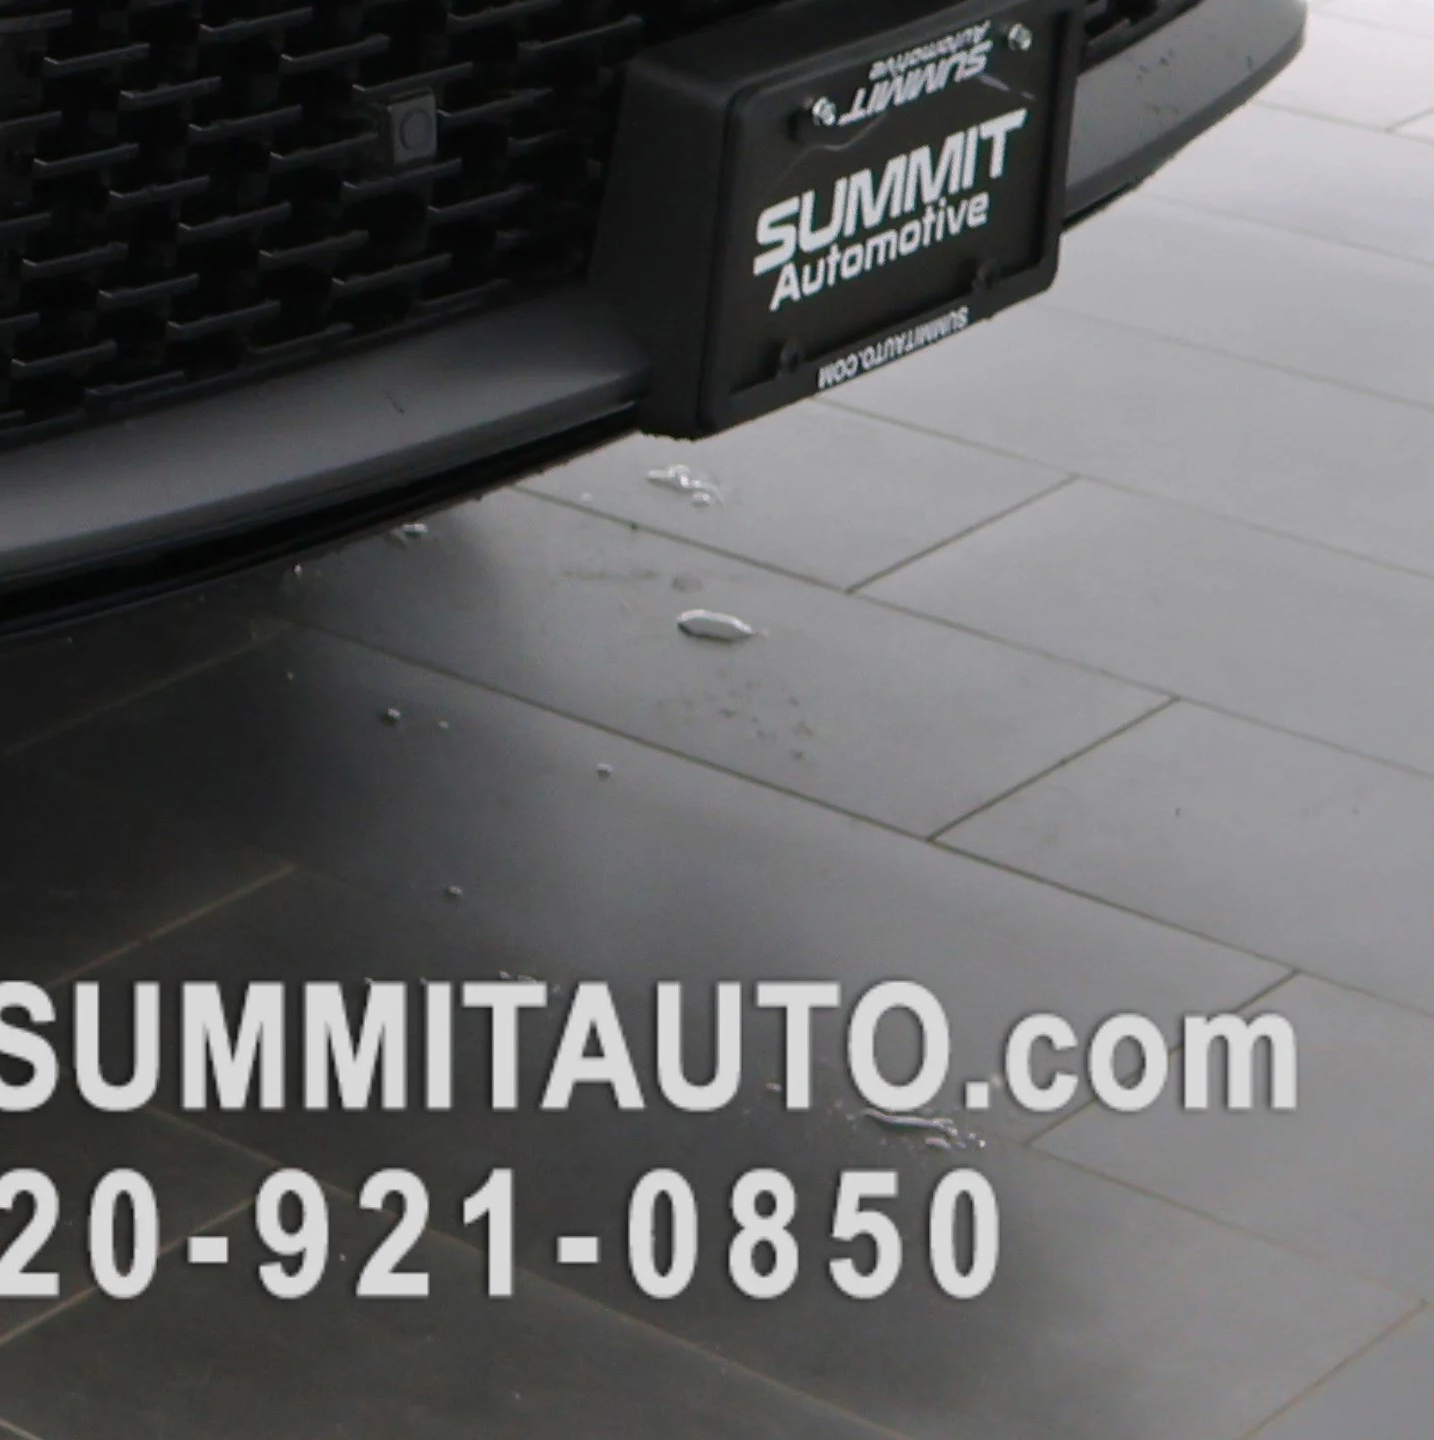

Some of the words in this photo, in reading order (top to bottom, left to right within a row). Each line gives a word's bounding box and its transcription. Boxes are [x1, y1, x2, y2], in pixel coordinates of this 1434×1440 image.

[837, 40, 993, 126] SUMMIT
[753, 108, 1027, 277] SUMMIT
[769, 191, 990, 312] Automotive
[817, 306, 969, 389] SUMMITAUTO.COM
